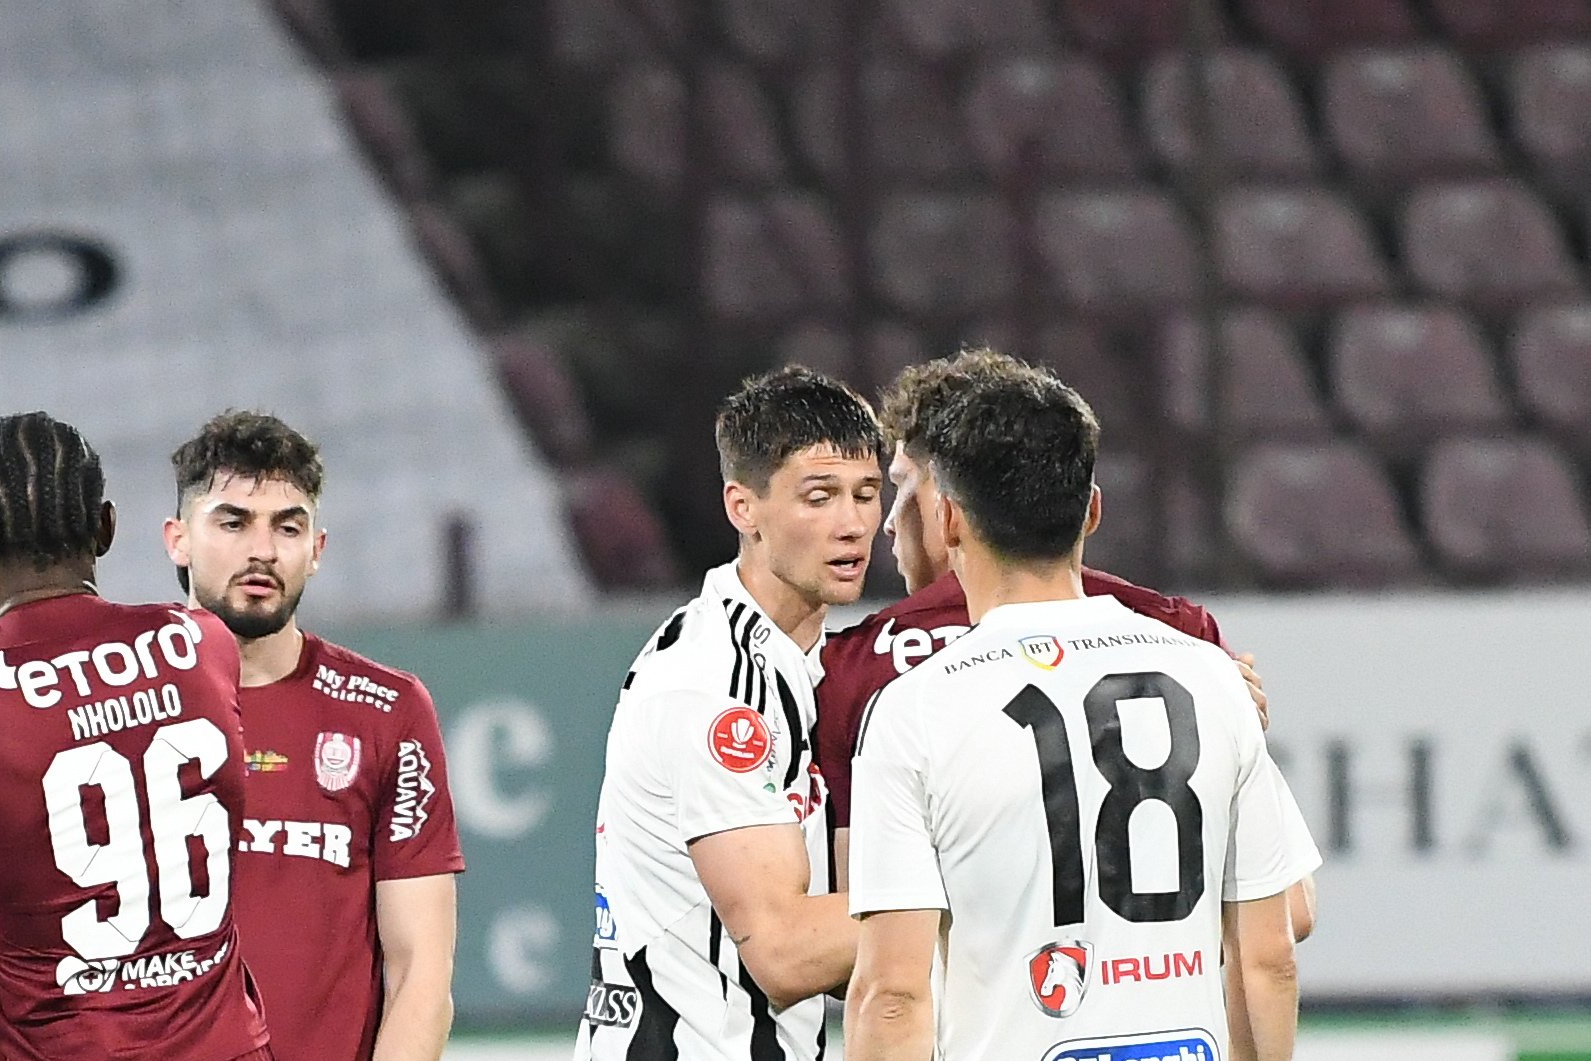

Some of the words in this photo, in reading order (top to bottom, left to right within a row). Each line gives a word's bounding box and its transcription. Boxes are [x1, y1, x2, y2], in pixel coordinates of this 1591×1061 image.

[944, 648, 1013, 675] BANCA
[1029, 641, 1053, 657] BT
[316, 664, 346, 690] My
[347, 675, 399, 702] Place
[389, 741, 419, 843] AQUAVIA
[1002, 671, 1205, 927] 18
[41, 717, 231, 961] 96
[238, 818, 353, 869] YER
[121, 950, 198, 981] MAKE
[1101, 950, 1204, 986] IRUM
